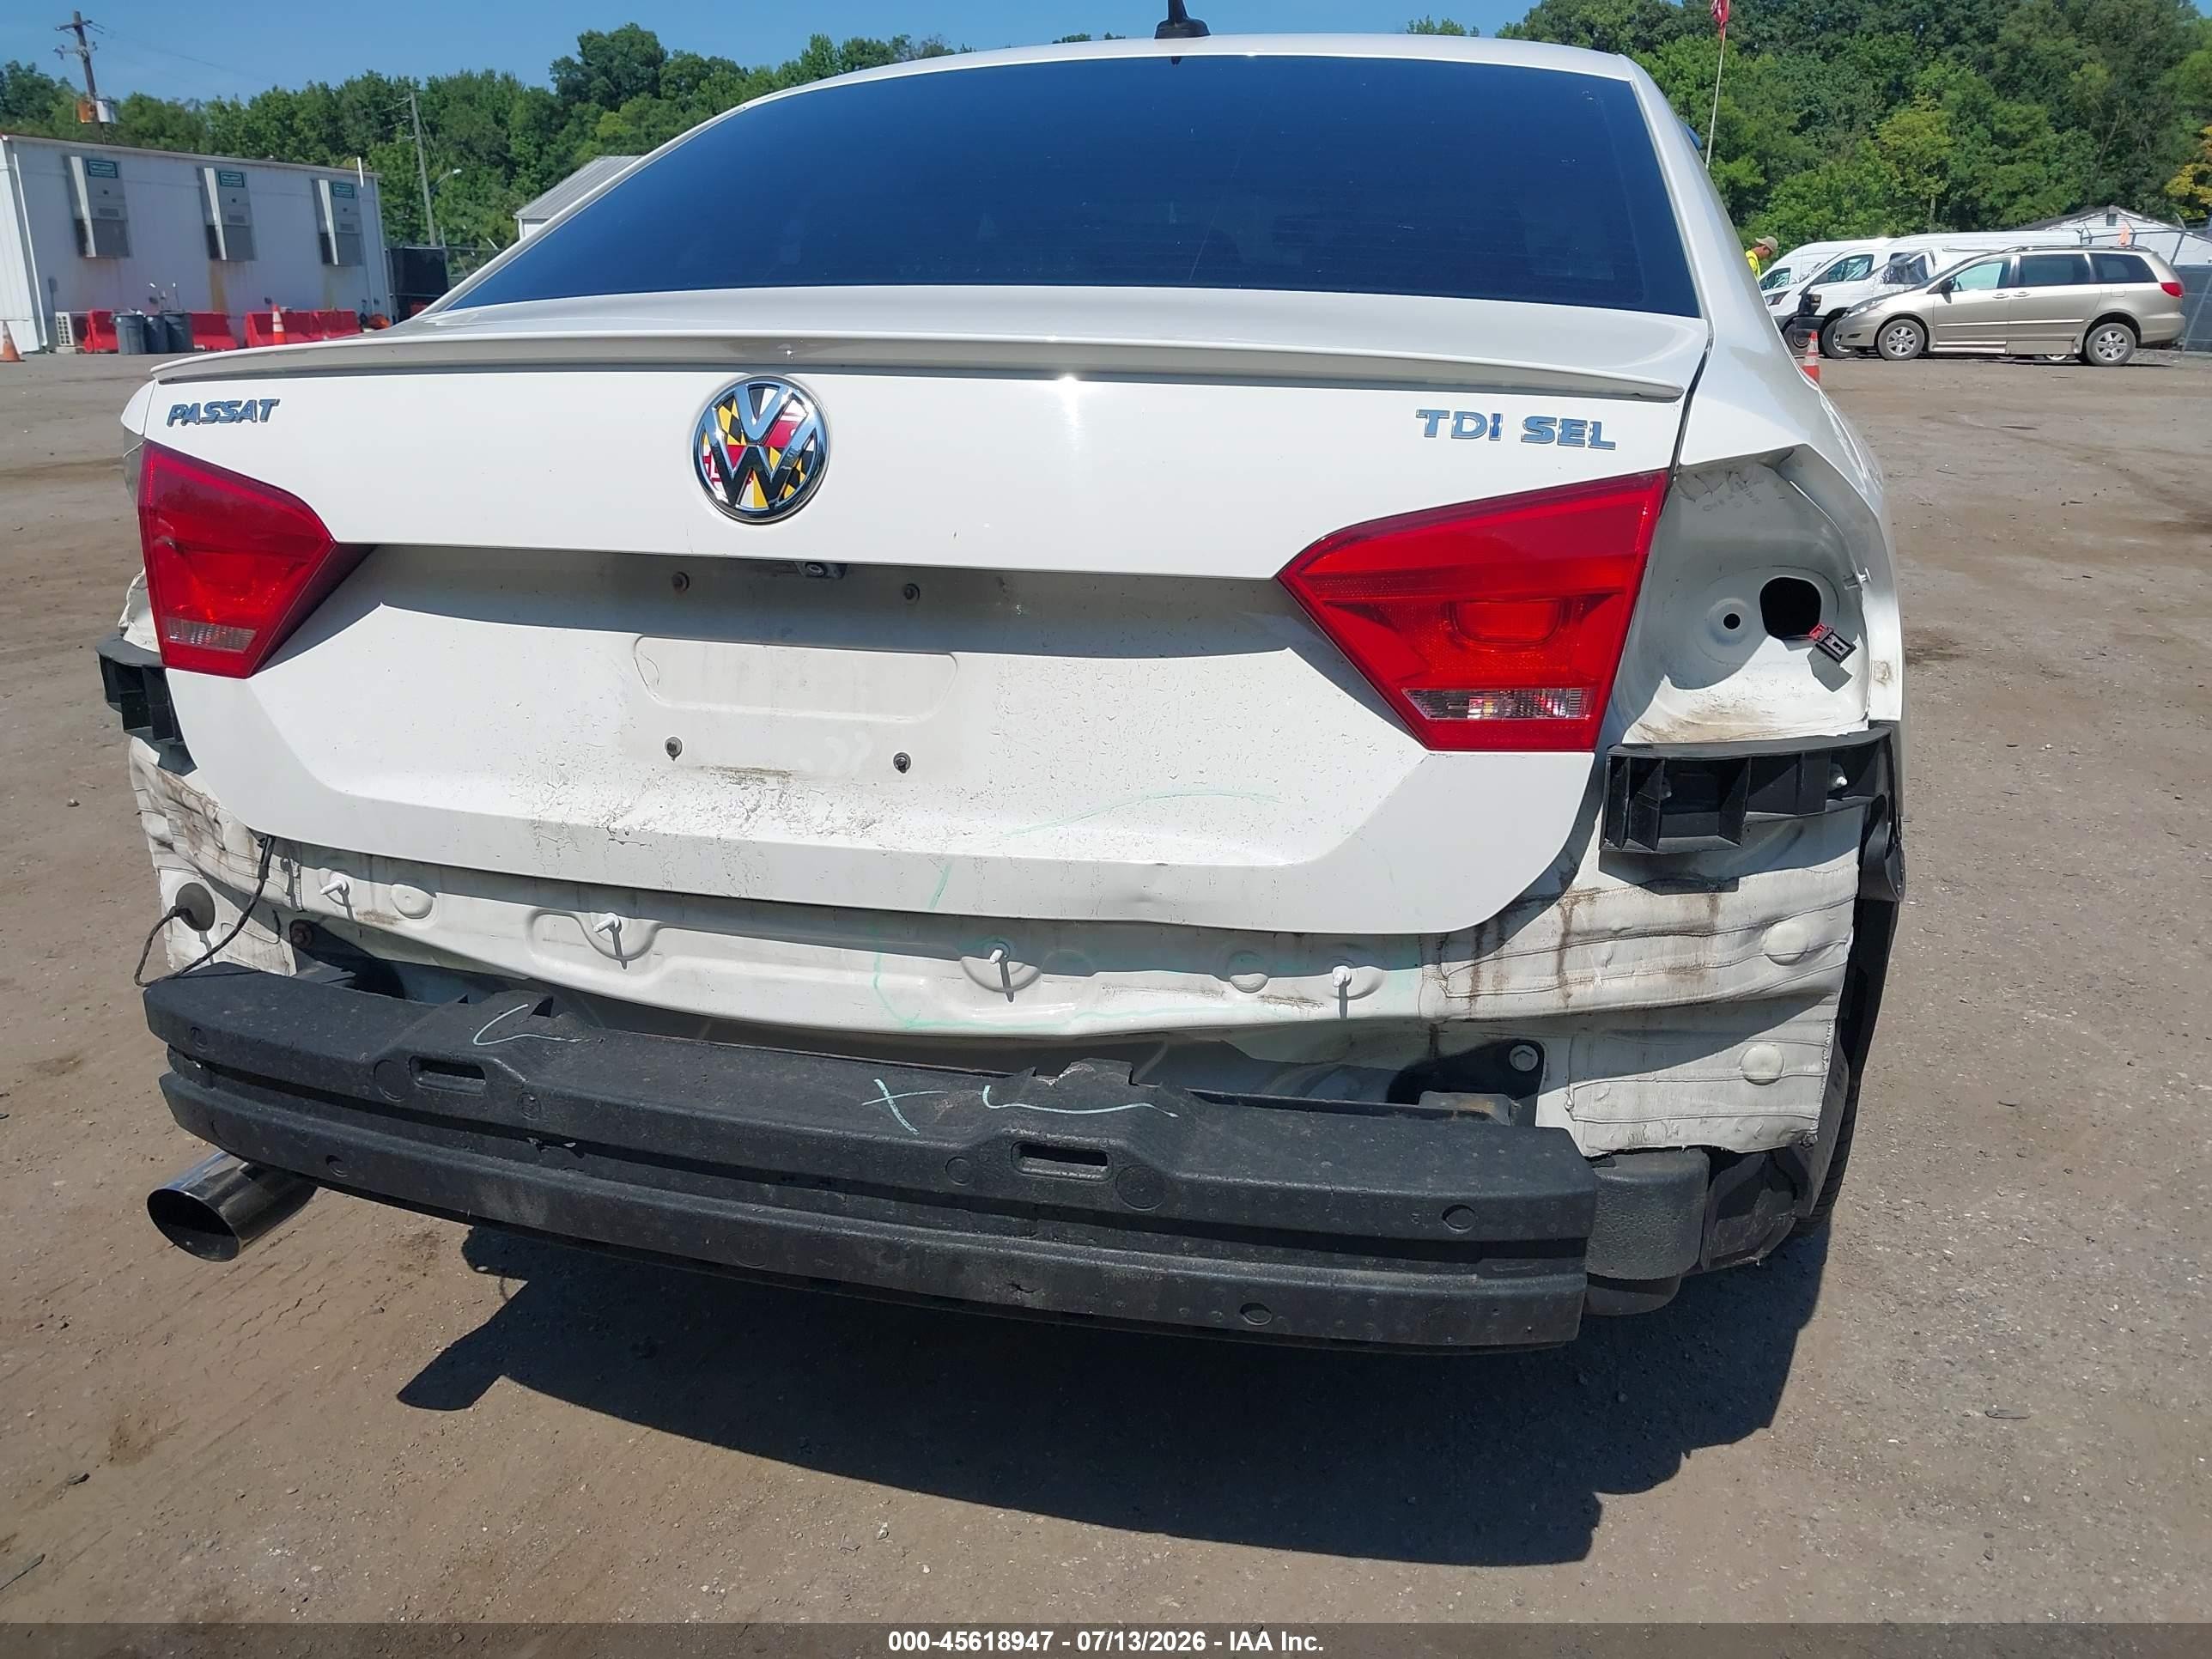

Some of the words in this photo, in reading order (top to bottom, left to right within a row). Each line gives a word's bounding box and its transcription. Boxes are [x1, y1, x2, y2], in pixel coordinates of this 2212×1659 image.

[167, 398, 280, 427] PASSAT
[1416, 409, 1504, 441] TDI
[1521, 416, 1616, 450] SEL
